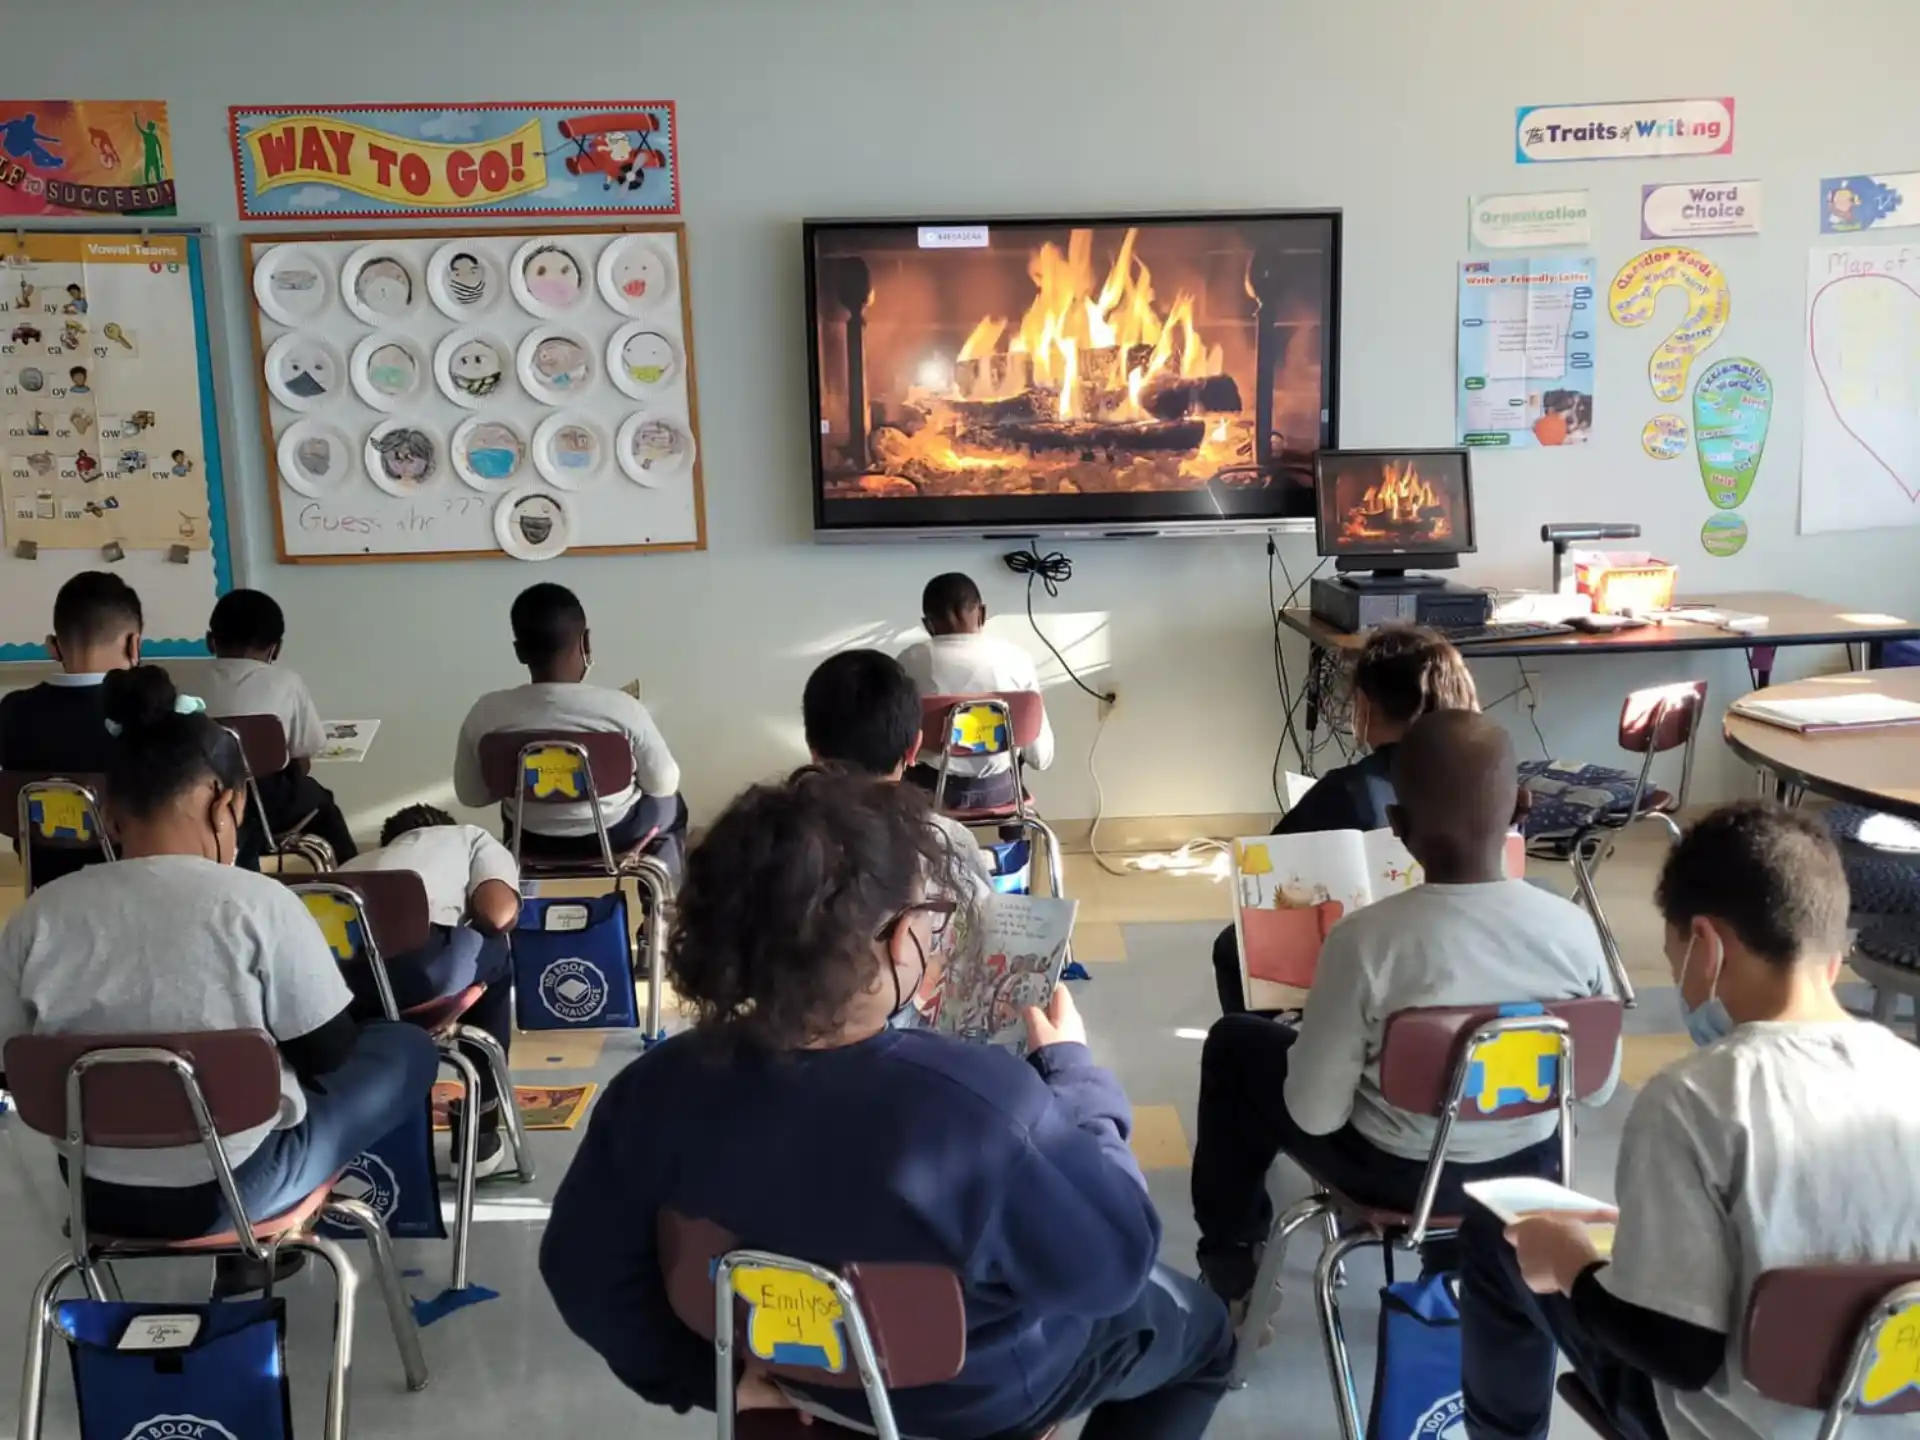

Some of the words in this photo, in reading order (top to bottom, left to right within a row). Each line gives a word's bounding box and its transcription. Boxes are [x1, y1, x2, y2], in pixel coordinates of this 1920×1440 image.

[1546, 122, 1617, 143] Traits
[1635, 118, 1721, 139] Writng
[258, 125, 355, 179] WAY
[367, 141, 431, 196] TO
[445, 141, 526, 198] GO!
[49, 183, 173, 207] SUCCEED!
[1688, 186, 1738, 202] Word
[1681, 203, 1745, 219] Choice
[87, 243, 130, 257] Vowel
[132, 245, 178, 257] Teams
[1828, 252, 1874, 277] Map
[1884, 247, 1911, 271] of
[1466, 274, 1495, 285] Write
[1511, 272, 1555, 286] Friendly
[102, 429, 121, 438] ow
[13, 469, 29, 479] ou
[60, 469, 76, 479] oo
[553, 962, 586, 975] BOOK
[555, 988, 602, 1017] CHALLENGE
[1422, 1411, 1446, 1433] 100
[148, 1422, 209, 1439] BOOK
